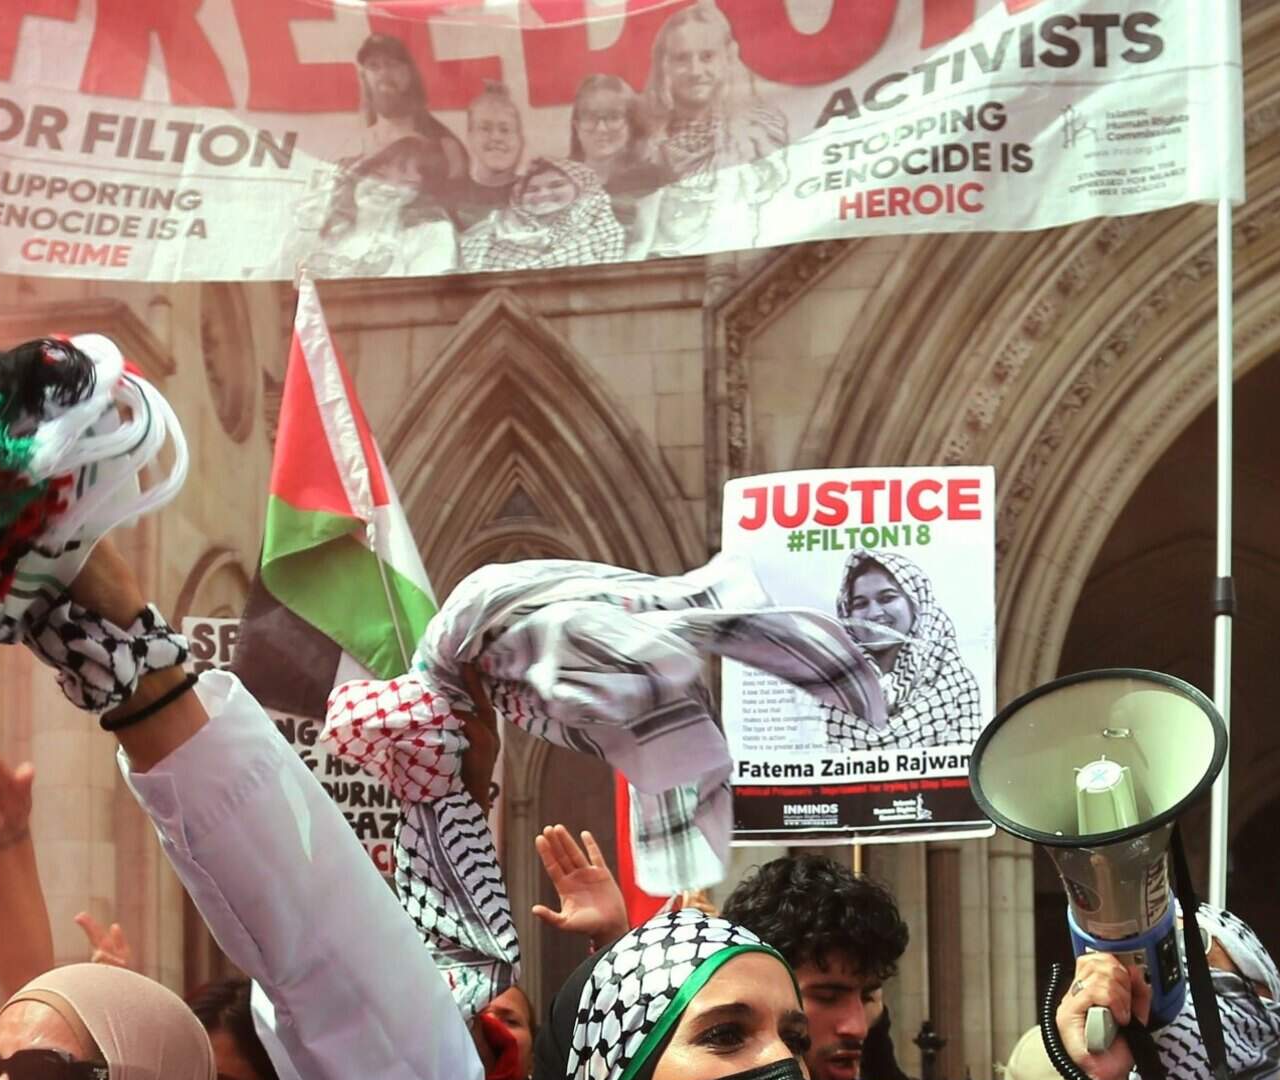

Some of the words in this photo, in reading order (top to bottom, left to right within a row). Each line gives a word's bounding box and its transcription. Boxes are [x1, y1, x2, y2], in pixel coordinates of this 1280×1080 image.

[815, 12, 1164, 128] ACTIVISTS
[80, 112, 298, 170] FILTON
[821, 101, 1007, 166] STOPPING
[794, 143, 996, 201] GENOCIDE
[1001, 143, 1034, 174] IS
[839, 182, 984, 221] HEROIC
[146, 218, 176, 241] IS
[183, 217, 208, 240] A
[20, 238, 132, 268] CRIME
[739, 479, 981, 531] JUSTICE
[787, 524, 931, 551] #FILTON18
[739, 761, 814, 779] Fatema
[821, 755, 889, 777] Zainab
[896, 751, 971, 776] Rajwan
[783, 804, 839, 815] INMINDS
